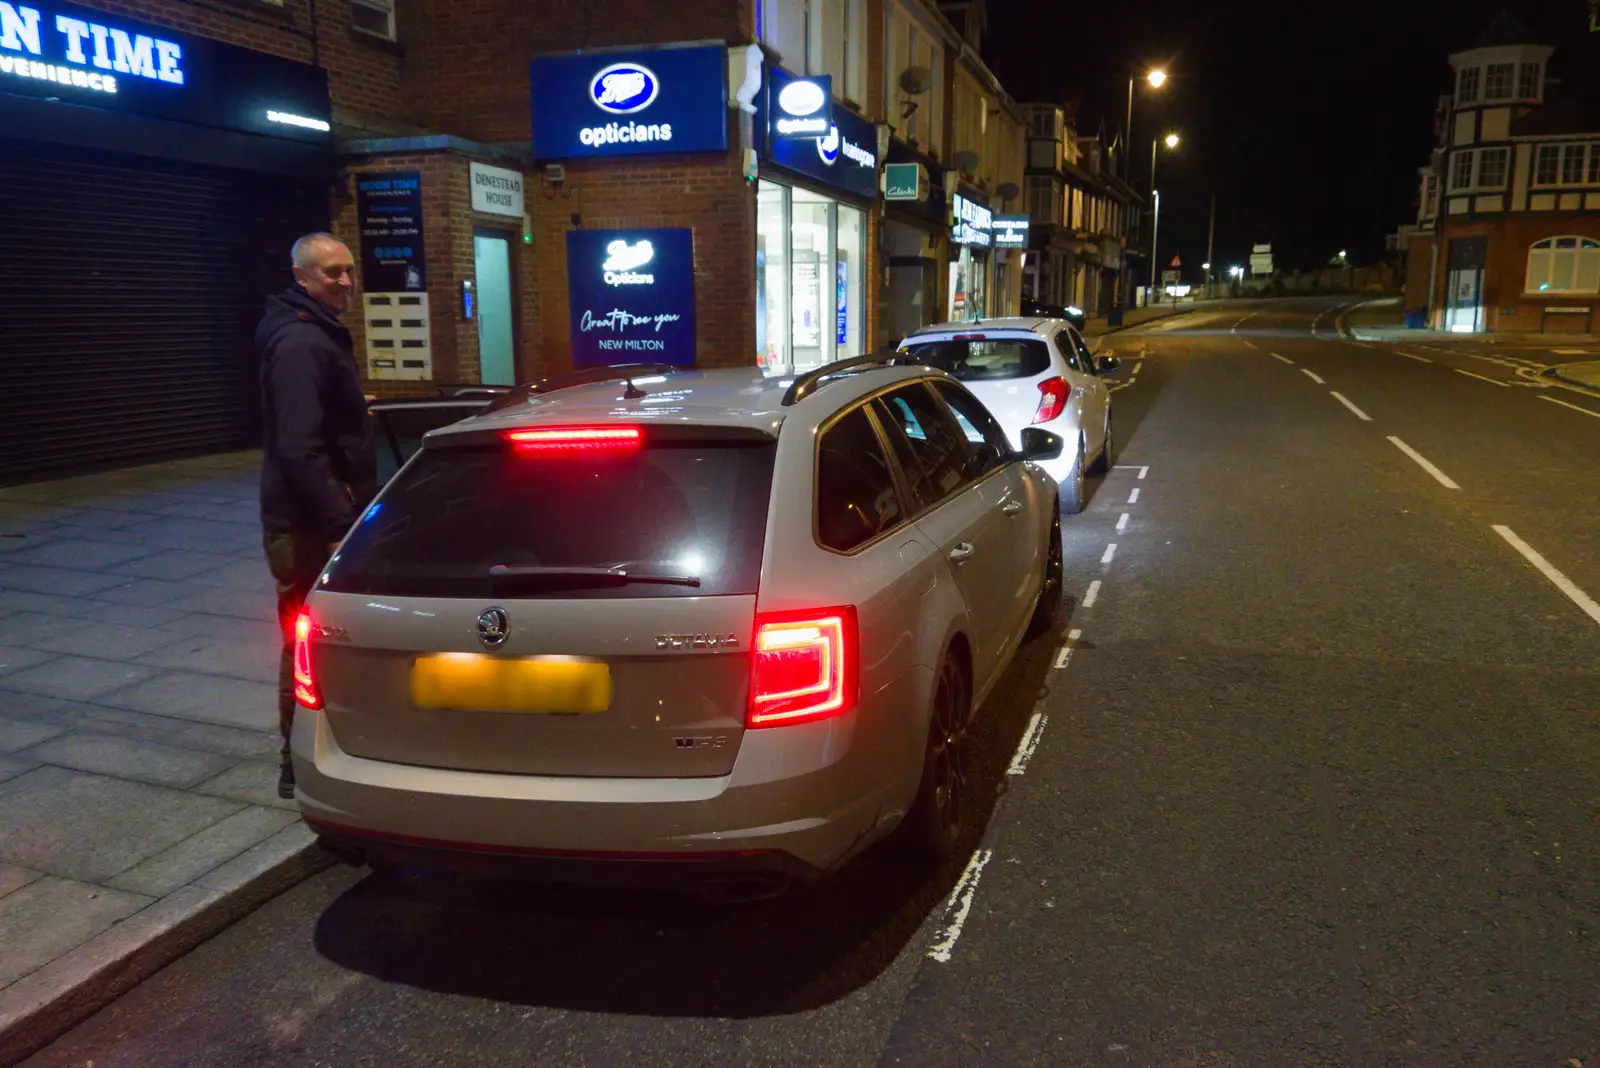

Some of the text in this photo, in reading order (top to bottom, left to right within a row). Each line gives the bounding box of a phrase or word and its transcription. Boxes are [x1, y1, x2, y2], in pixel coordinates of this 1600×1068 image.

[55, 15, 184, 85] TIME
[580, 121, 673, 148] opticians
[474, 171, 521, 193] DENESTEAD
[485, 190, 513, 207] HOUSE
[887, 186, 916, 197] Clarks
[603, 271, 654, 288] Opticians
[653, 313, 681, 333] you
[598, 339, 665, 351] NEW MILTON
[655, 633, 740, 650] OCTAVIA
